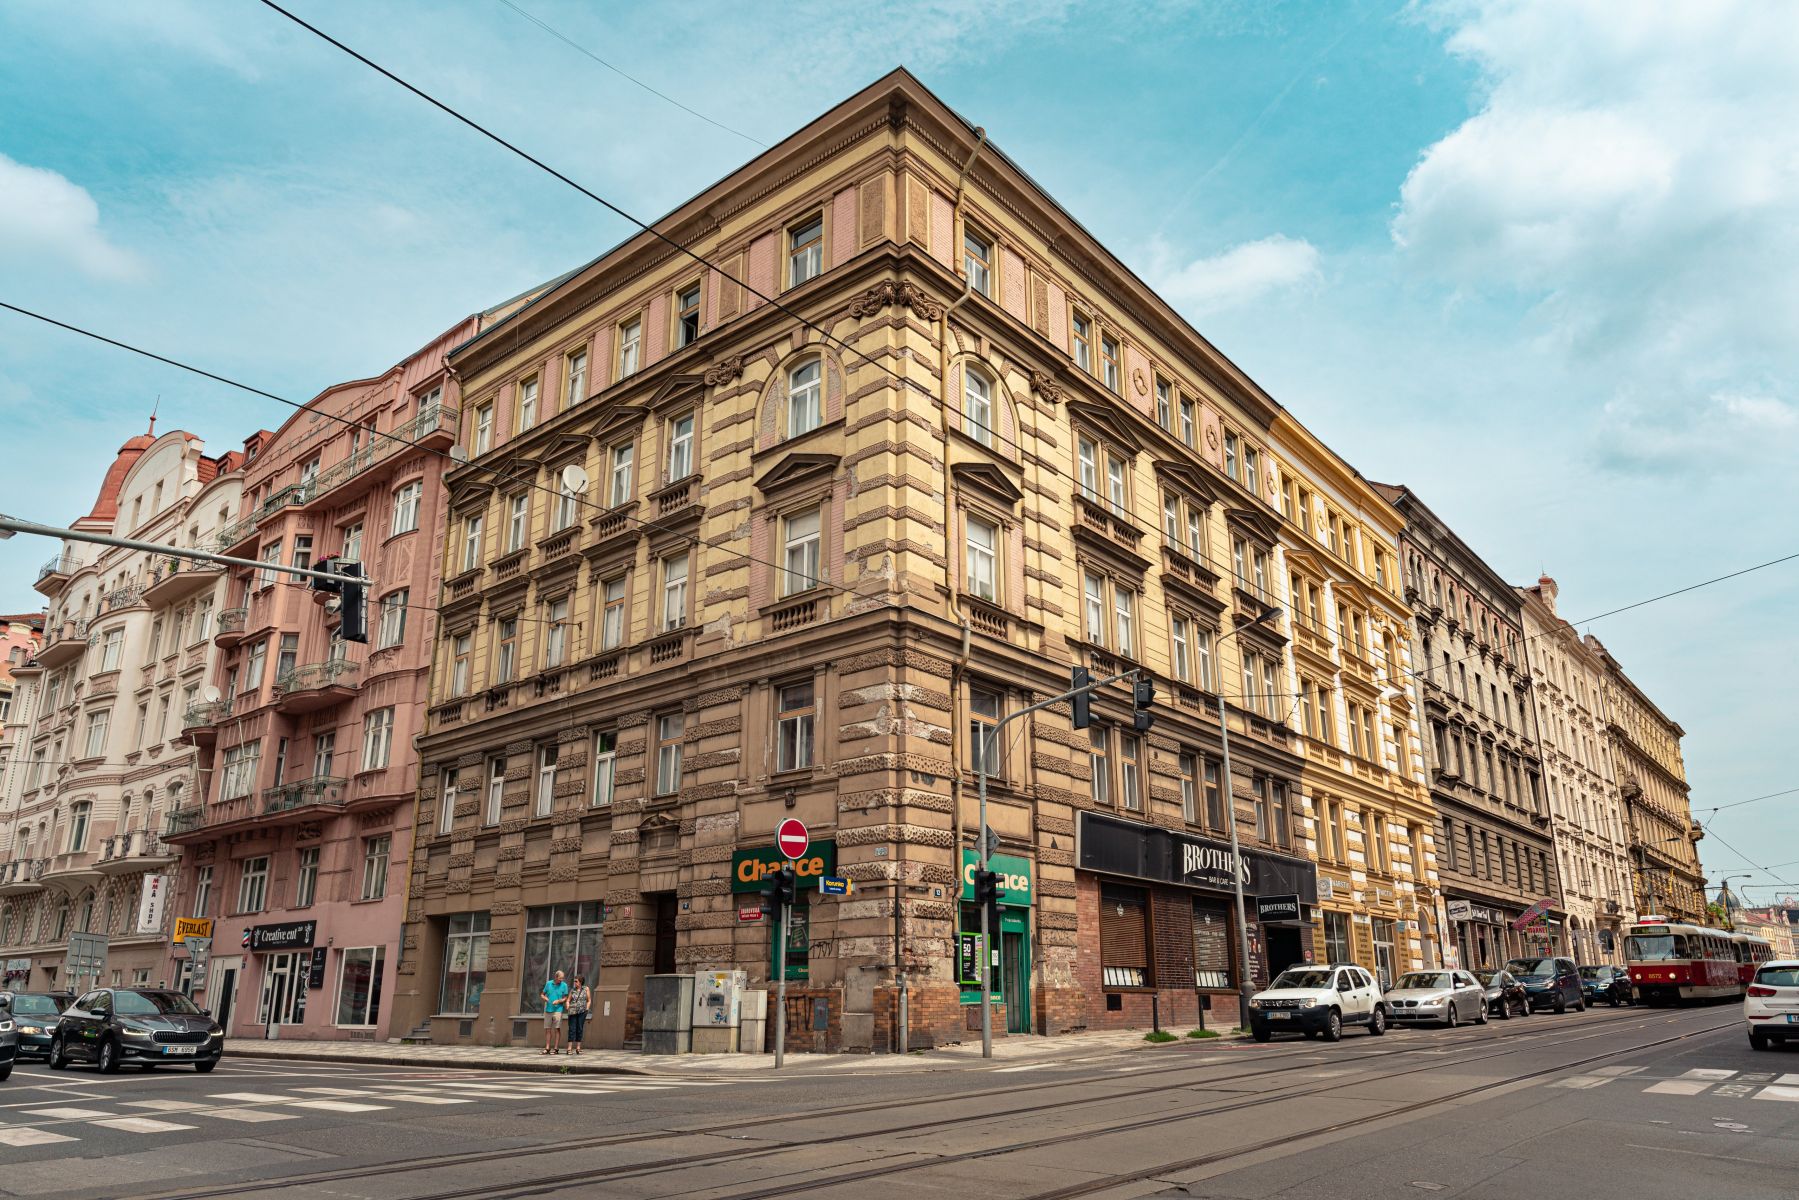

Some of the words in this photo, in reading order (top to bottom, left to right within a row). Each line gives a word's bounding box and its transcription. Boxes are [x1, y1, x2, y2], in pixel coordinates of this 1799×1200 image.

[1259, 902, 1297, 914] BROTHERS
[177, 920, 210, 937] EVERLAST
[261, 928, 286, 942] Creative
[286, 928, 297, 940] cut
